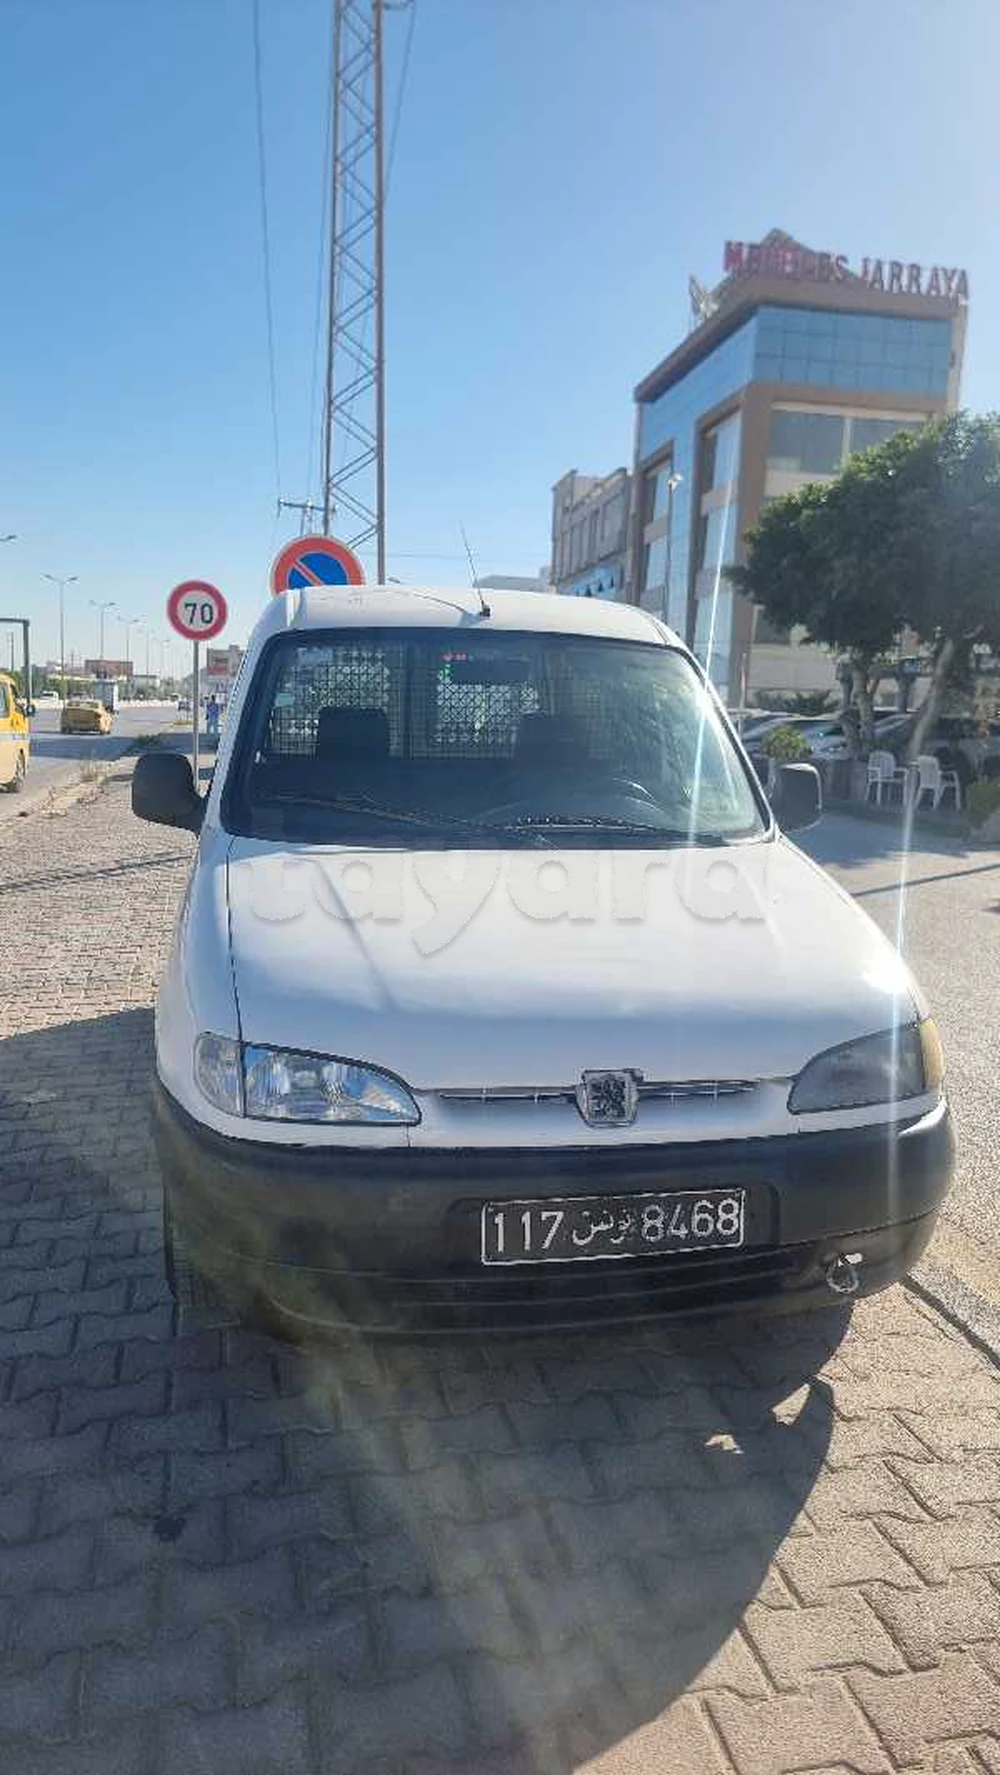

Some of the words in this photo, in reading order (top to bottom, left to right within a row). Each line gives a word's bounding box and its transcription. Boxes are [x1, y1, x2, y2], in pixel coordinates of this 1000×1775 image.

[861, 255, 969, 298] JARRAYA
[184, 602, 214, 624] 70
[494, 1210, 564, 1252] 117
[571, 1209, 632, 1245] تونس
[641, 1198, 739, 1242] 8468
